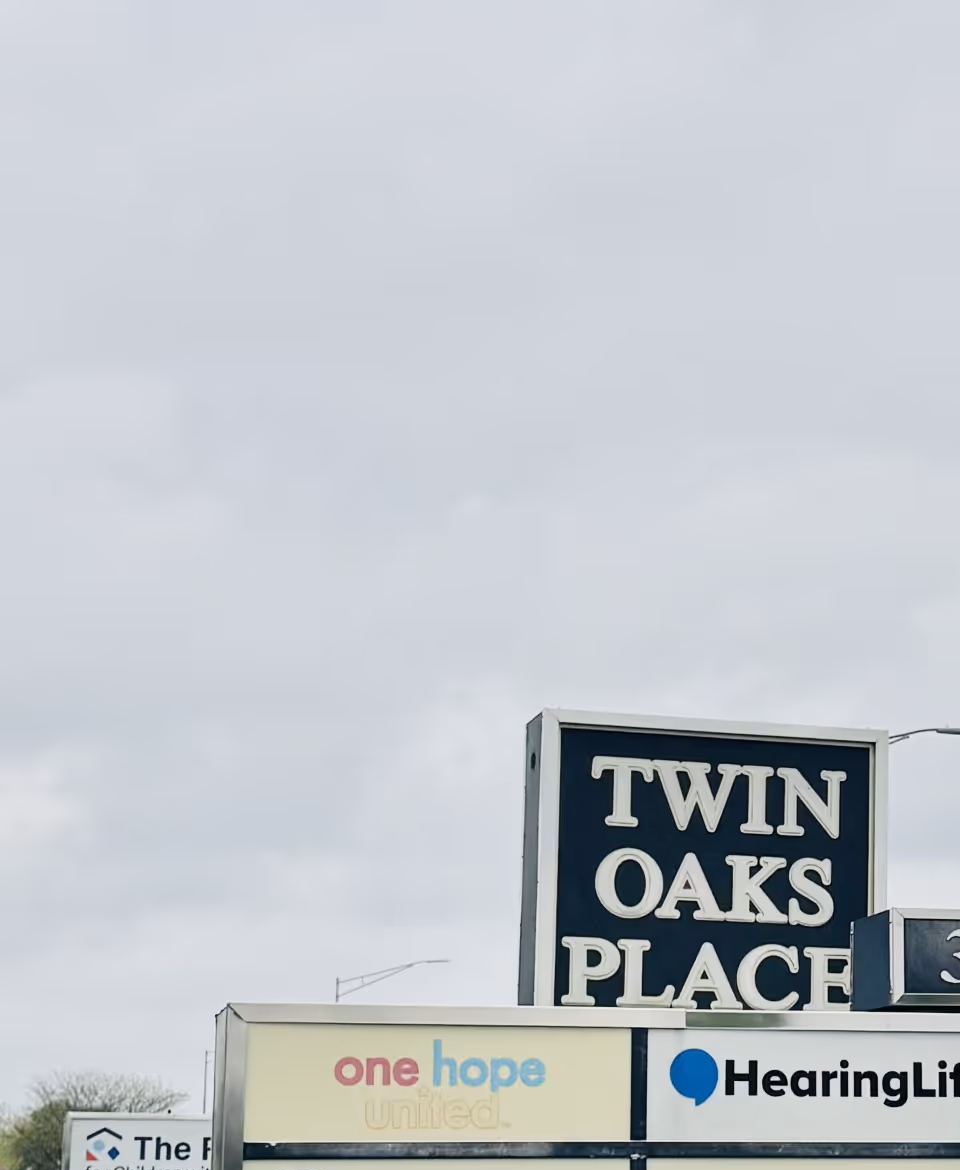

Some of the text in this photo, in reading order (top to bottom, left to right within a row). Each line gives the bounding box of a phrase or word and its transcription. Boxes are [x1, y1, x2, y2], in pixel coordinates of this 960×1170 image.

[591, 755, 847, 839] TWIN
[594, 847, 835, 927] OAKS
[561, 935, 852, 1011] PLACE
[334, 1039, 546, 1091] one hope
[134, 1137, 190, 1160] The
